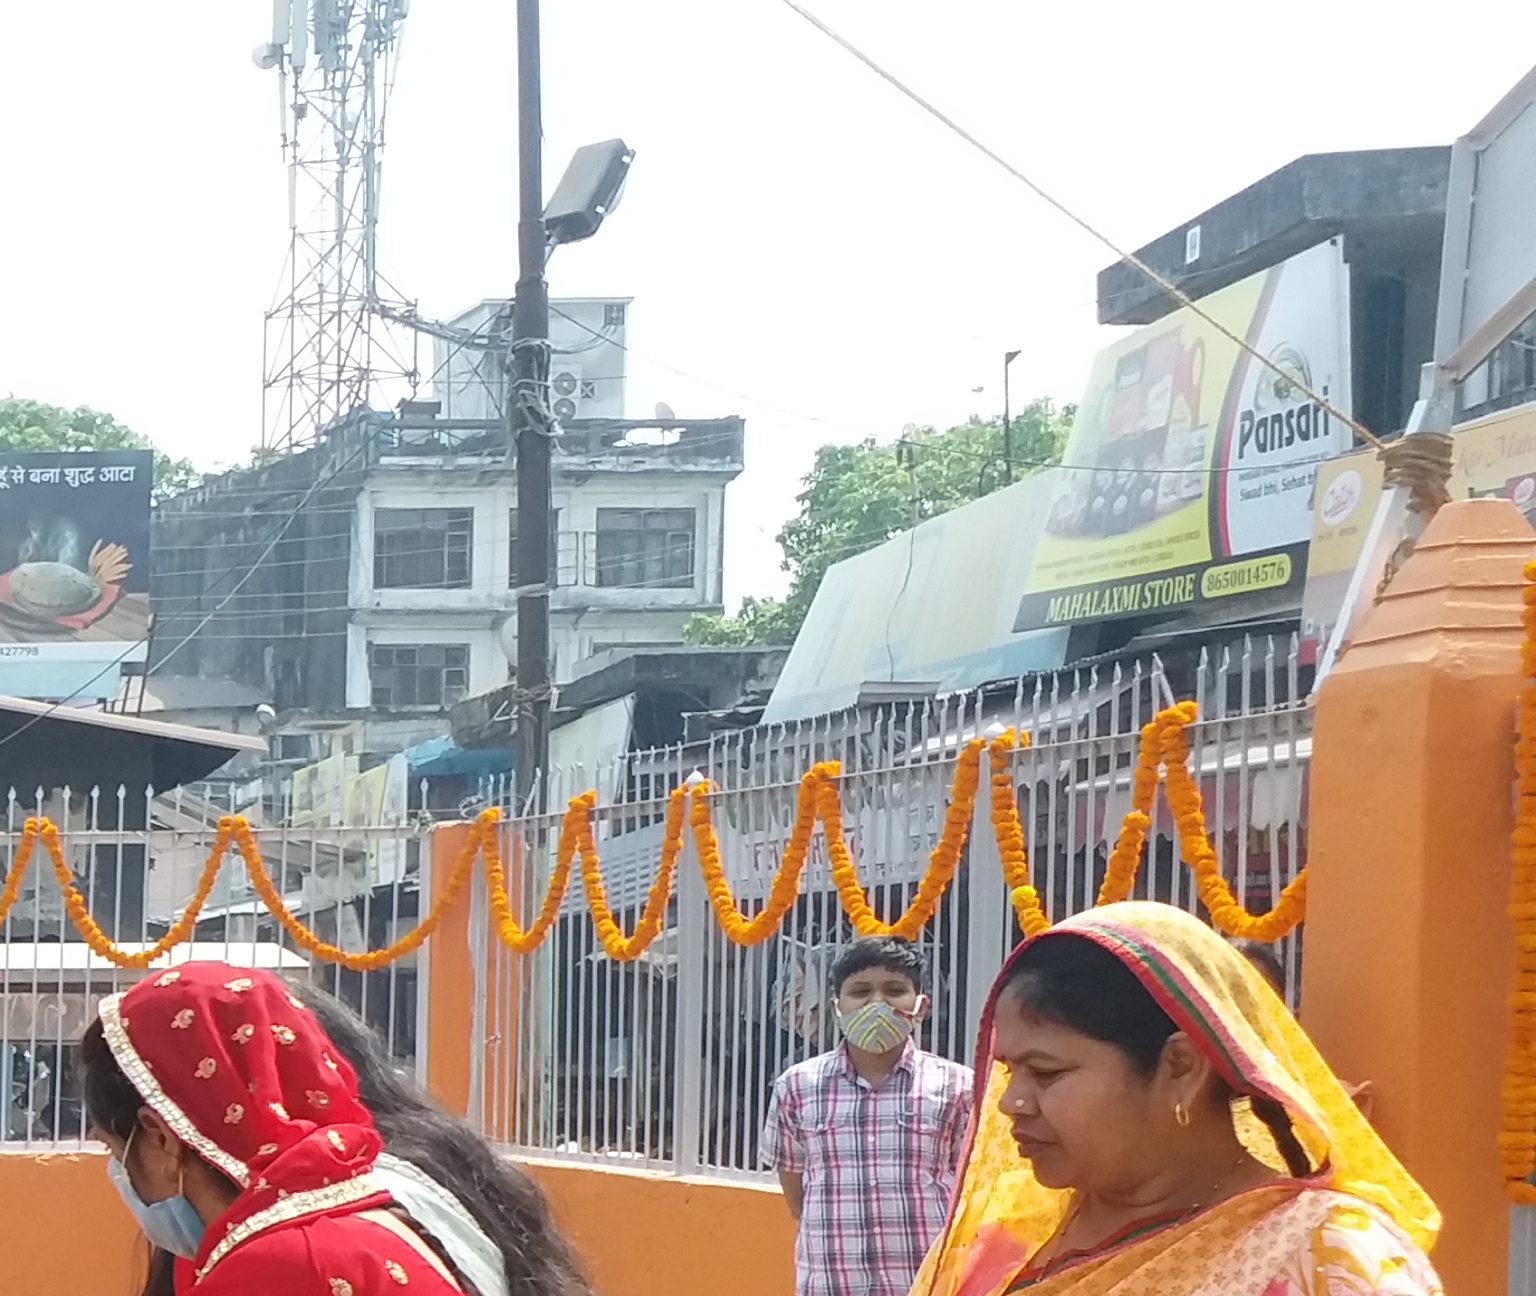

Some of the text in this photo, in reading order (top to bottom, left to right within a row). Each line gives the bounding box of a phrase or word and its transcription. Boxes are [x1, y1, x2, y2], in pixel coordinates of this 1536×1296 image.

[1238, 385, 1330, 460] Pansari
[11, 465, 25, 484] से
[28, 467, 61, 484] बना
[99, 465, 136, 482] आटा
[1240, 485, 1263, 502] Swad
[1044, 583, 1143, 622] MAHALAXMI
[1143, 573, 1196, 612] STORE
[1206, 561, 1285, 592] 8650014576
